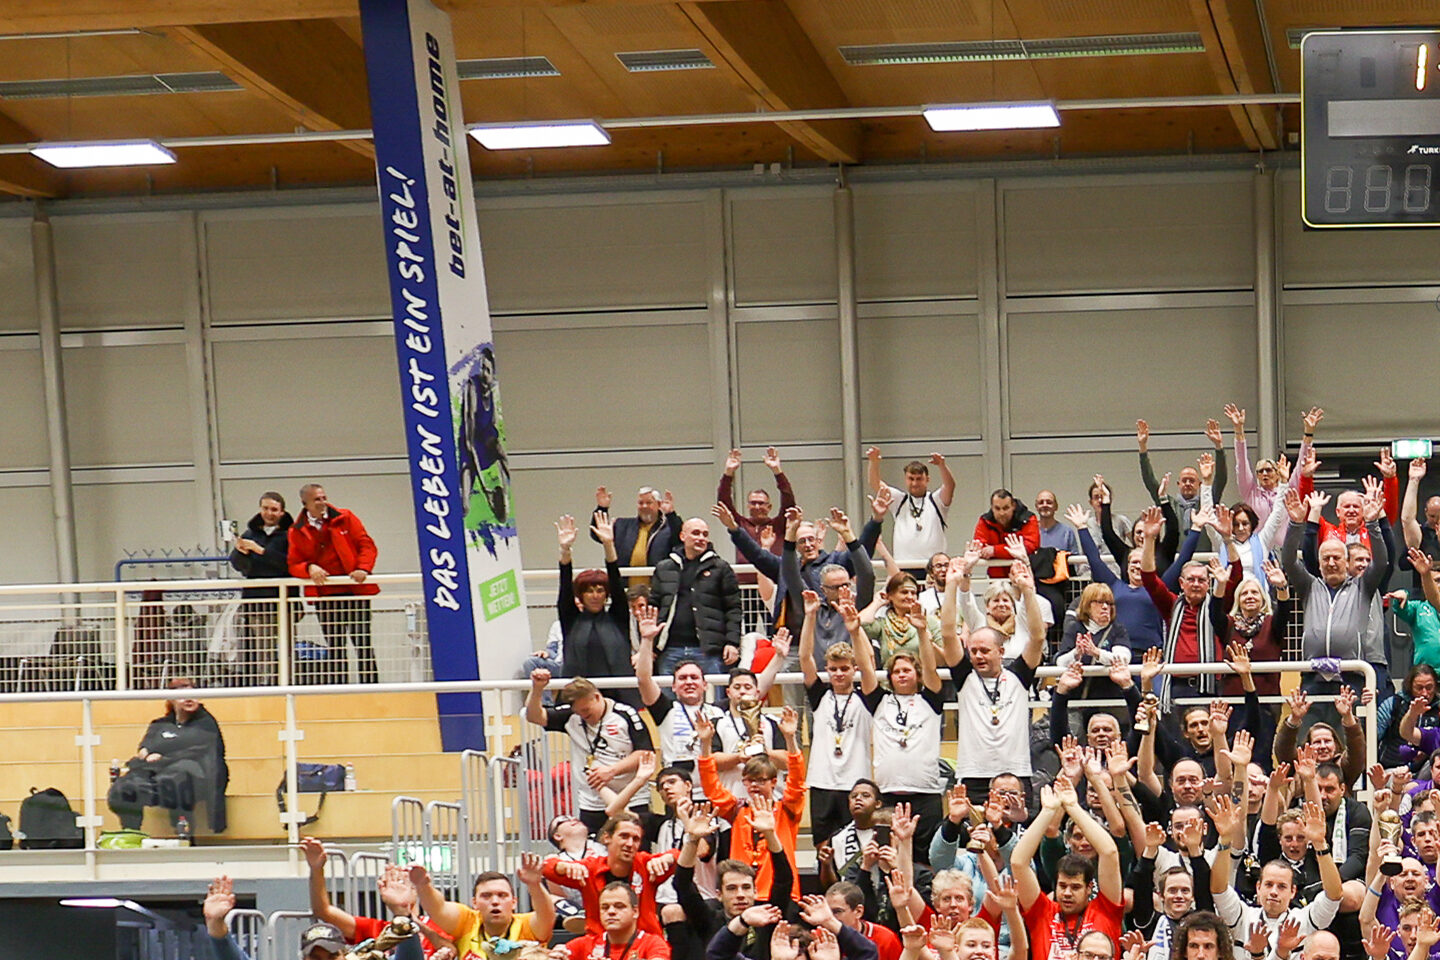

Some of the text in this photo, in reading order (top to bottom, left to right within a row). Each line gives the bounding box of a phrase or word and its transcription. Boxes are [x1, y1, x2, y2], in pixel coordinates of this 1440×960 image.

[425, 31, 466, 280] bet-at-home
[386, 166, 460, 611] DAS LEBEN IST EIN SPIEL!
